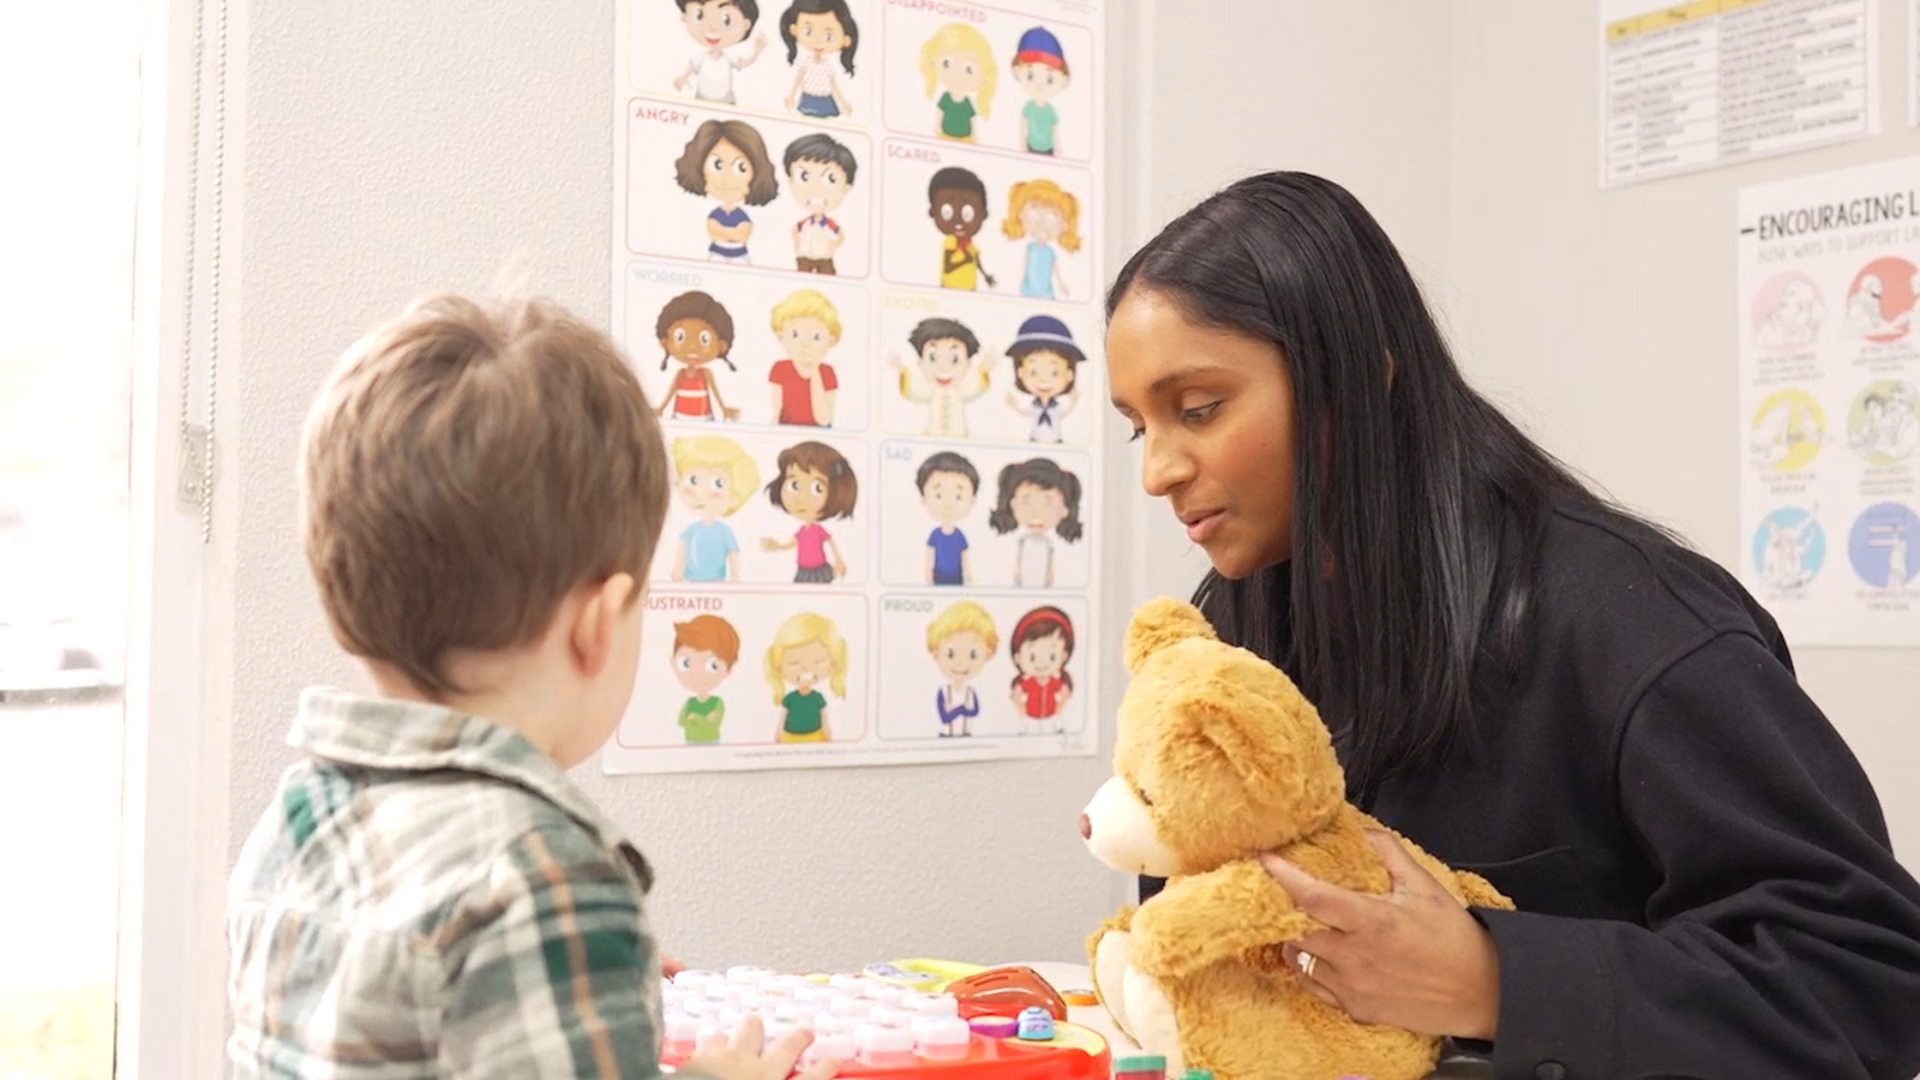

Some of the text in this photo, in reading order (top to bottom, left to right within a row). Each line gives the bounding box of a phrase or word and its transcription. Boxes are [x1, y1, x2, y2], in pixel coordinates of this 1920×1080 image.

[635, 107, 690, 127] ANGRY
[887, 143, 942, 164] SCARED
[1759, 191, 1904, 241] ENCOURAGING
[633, 267, 702, 288] WORRIED
[885, 446, 913, 462] SAD
[642, 596, 723, 611] RUSTRATED
[884, 598, 935, 614] PROUD
